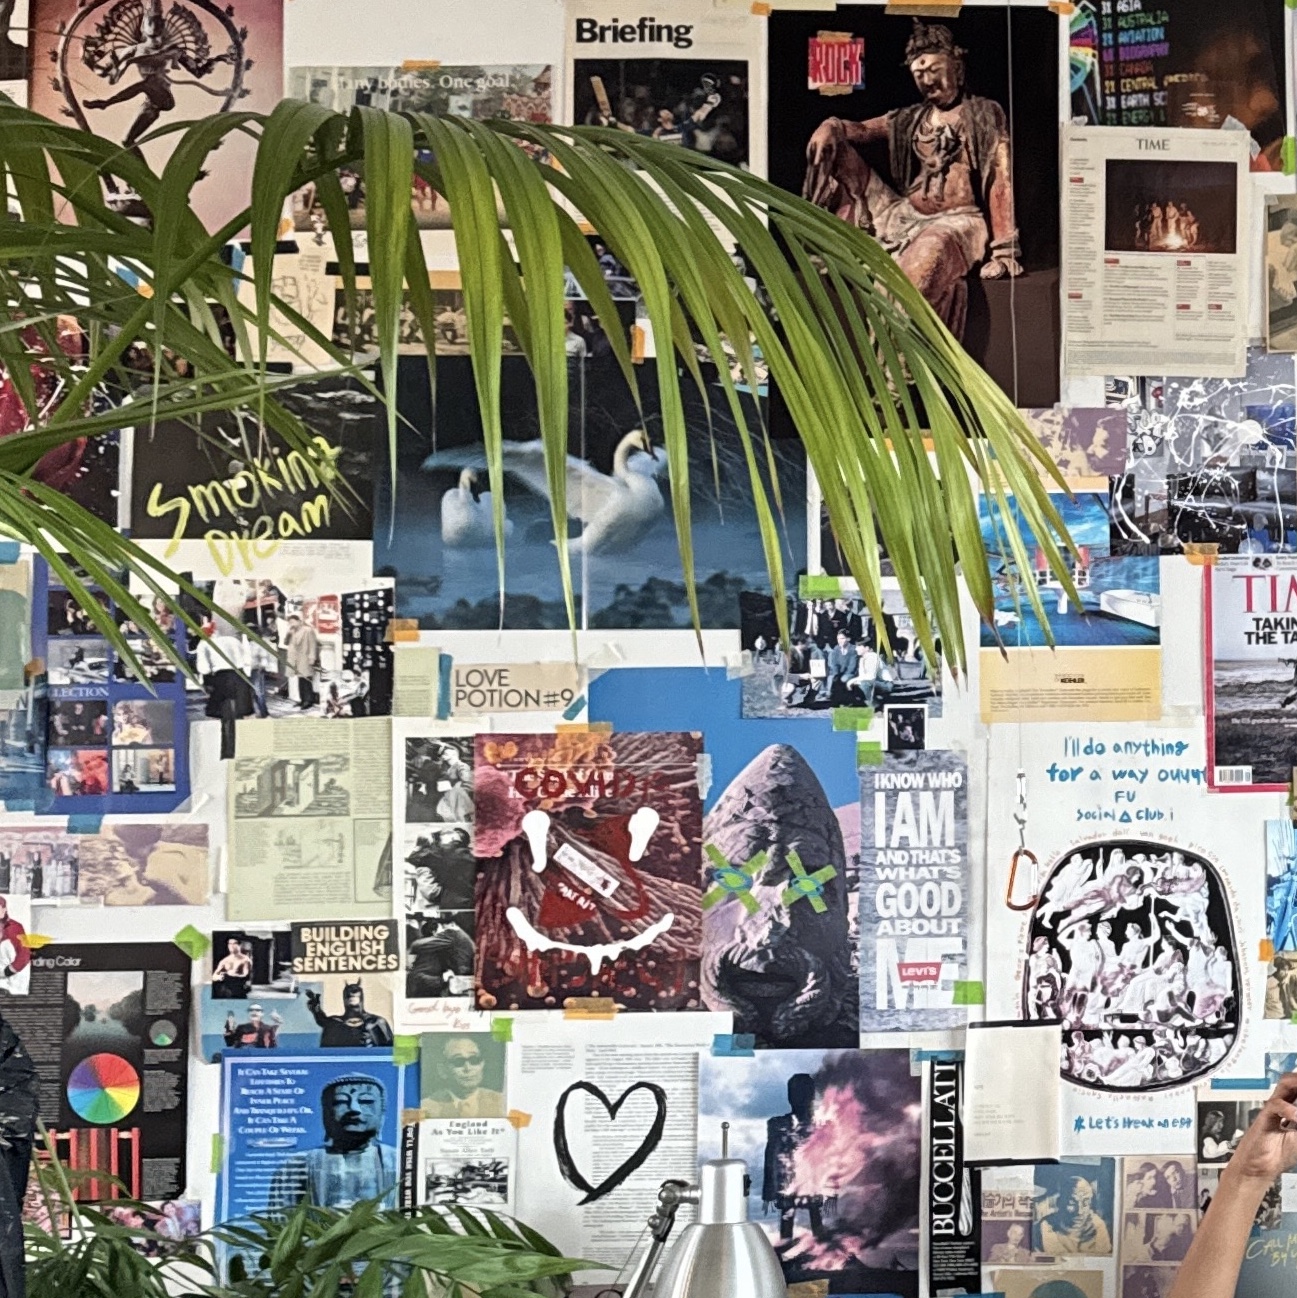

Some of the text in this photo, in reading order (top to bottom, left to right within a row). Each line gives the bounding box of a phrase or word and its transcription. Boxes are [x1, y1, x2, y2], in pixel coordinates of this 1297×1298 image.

[576, 18, 694, 48] Briefing
[811, 40, 863, 86] ROCK
[1136, 138, 1170, 151] TIME
[204, 494, 330, 577] Dream
[1244, 631, 1278, 645] THE
[455, 669, 510, 688] LOVE
[1083, 737, 1107, 756] do
[1112, 738, 1190, 758] anything
[874, 771, 963, 789] I KNOW WHO
[1045, 762, 1149, 784] for a way
[1115, 790, 1137, 803] FU
[874, 791, 955, 848] I AM
[876, 849, 962, 865] AND THAT'S
[875, 866, 962, 880] WHAT'S
[875, 881, 962, 918] GOOD
[300, 926, 389, 942] BUILDING
[876, 918, 962, 936] ABOUT
[305, 941, 385, 957] ENGLISH
[293, 955, 398, 972] SENTENCES
[876, 937, 963, 1010] ME
[449, 1120, 488, 1128] England
[932, 1063, 957, 1237] BUCCELLATI
[1246, 1237, 1283, 1260] CALL
